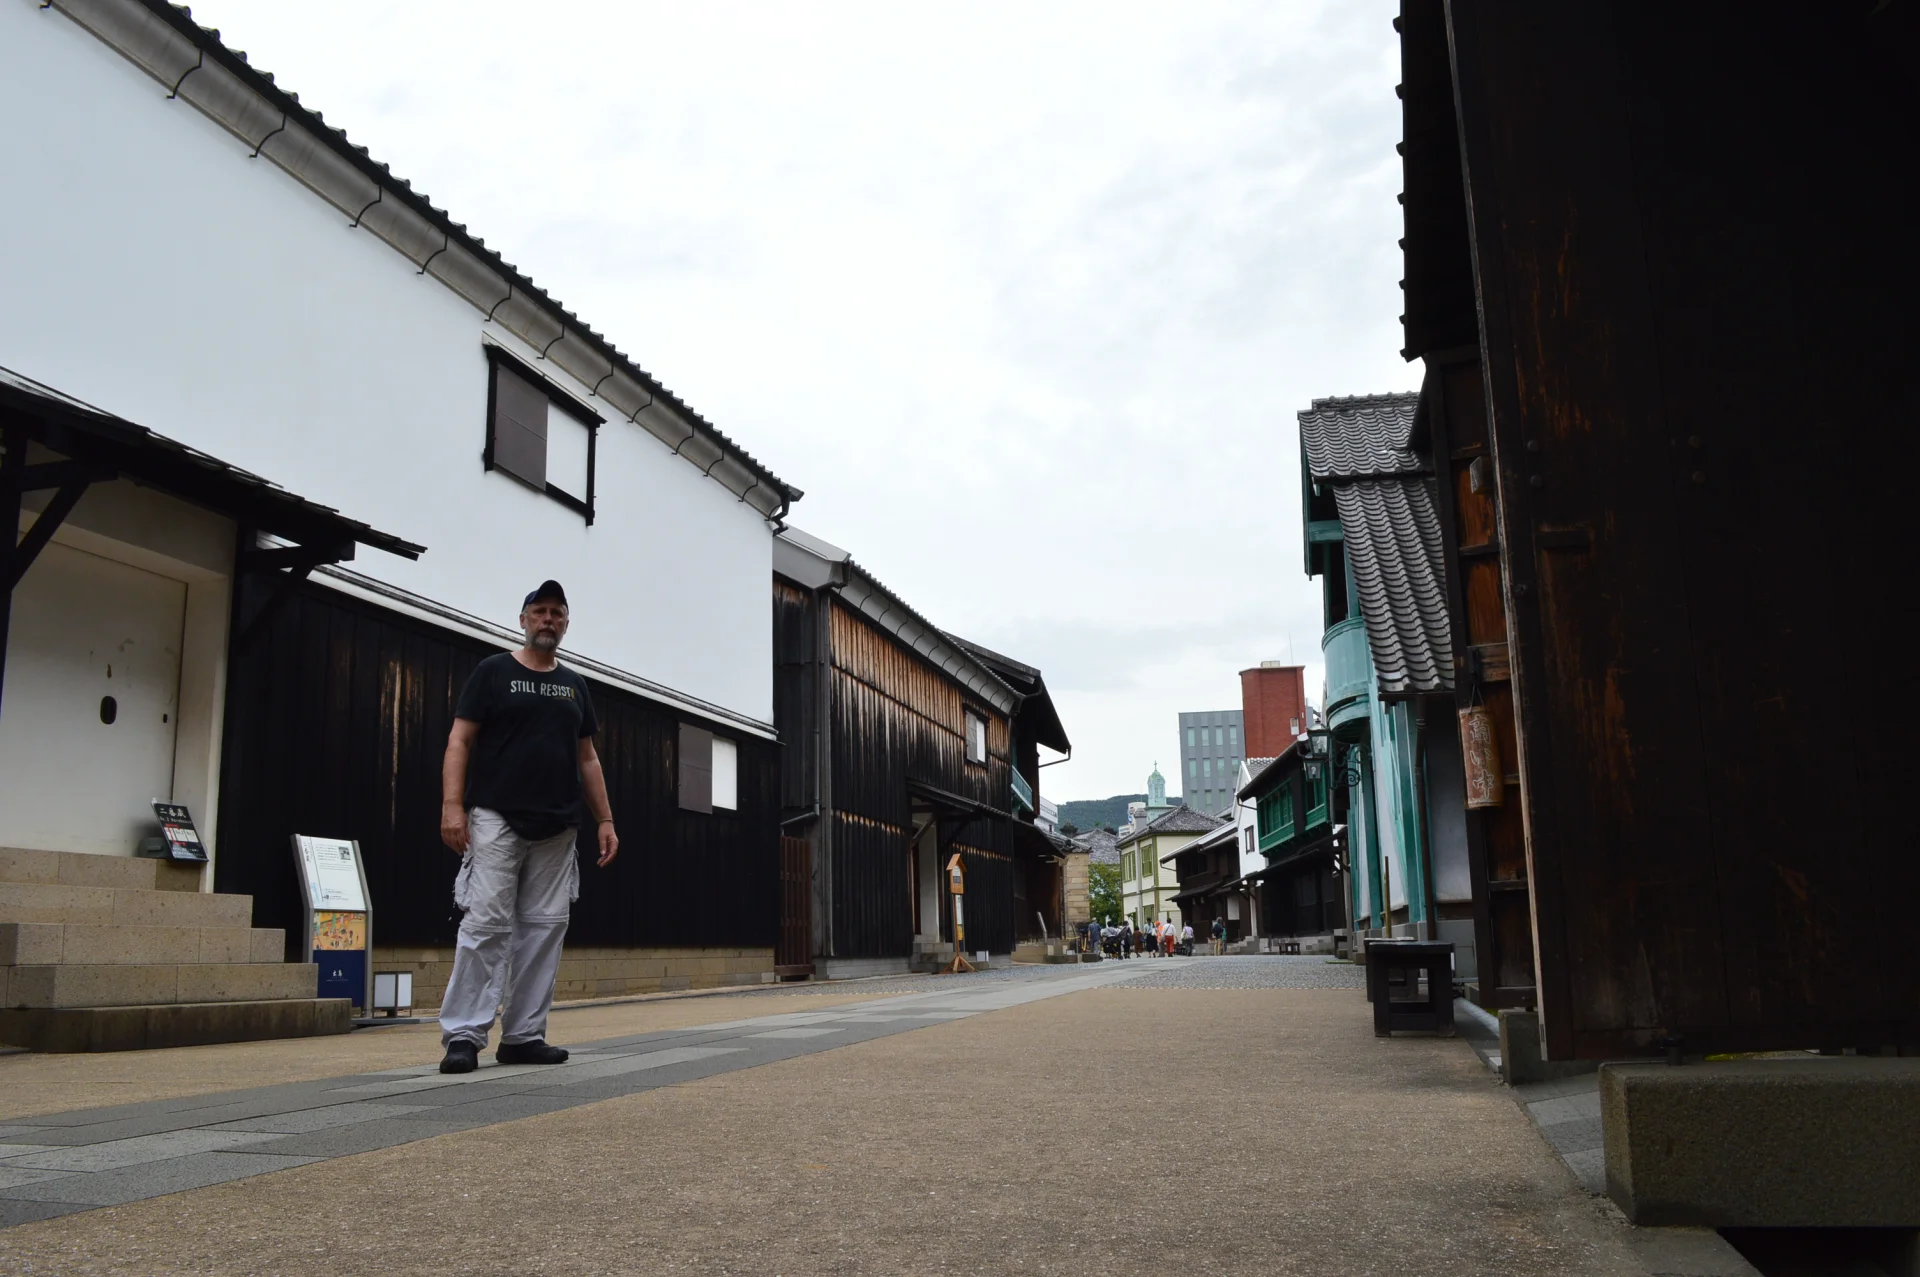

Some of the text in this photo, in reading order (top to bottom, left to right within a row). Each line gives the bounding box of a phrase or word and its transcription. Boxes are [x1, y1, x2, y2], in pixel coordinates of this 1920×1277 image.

[510, 680, 536, 694] STILL
[1468, 713, 1495, 800] 商い中
